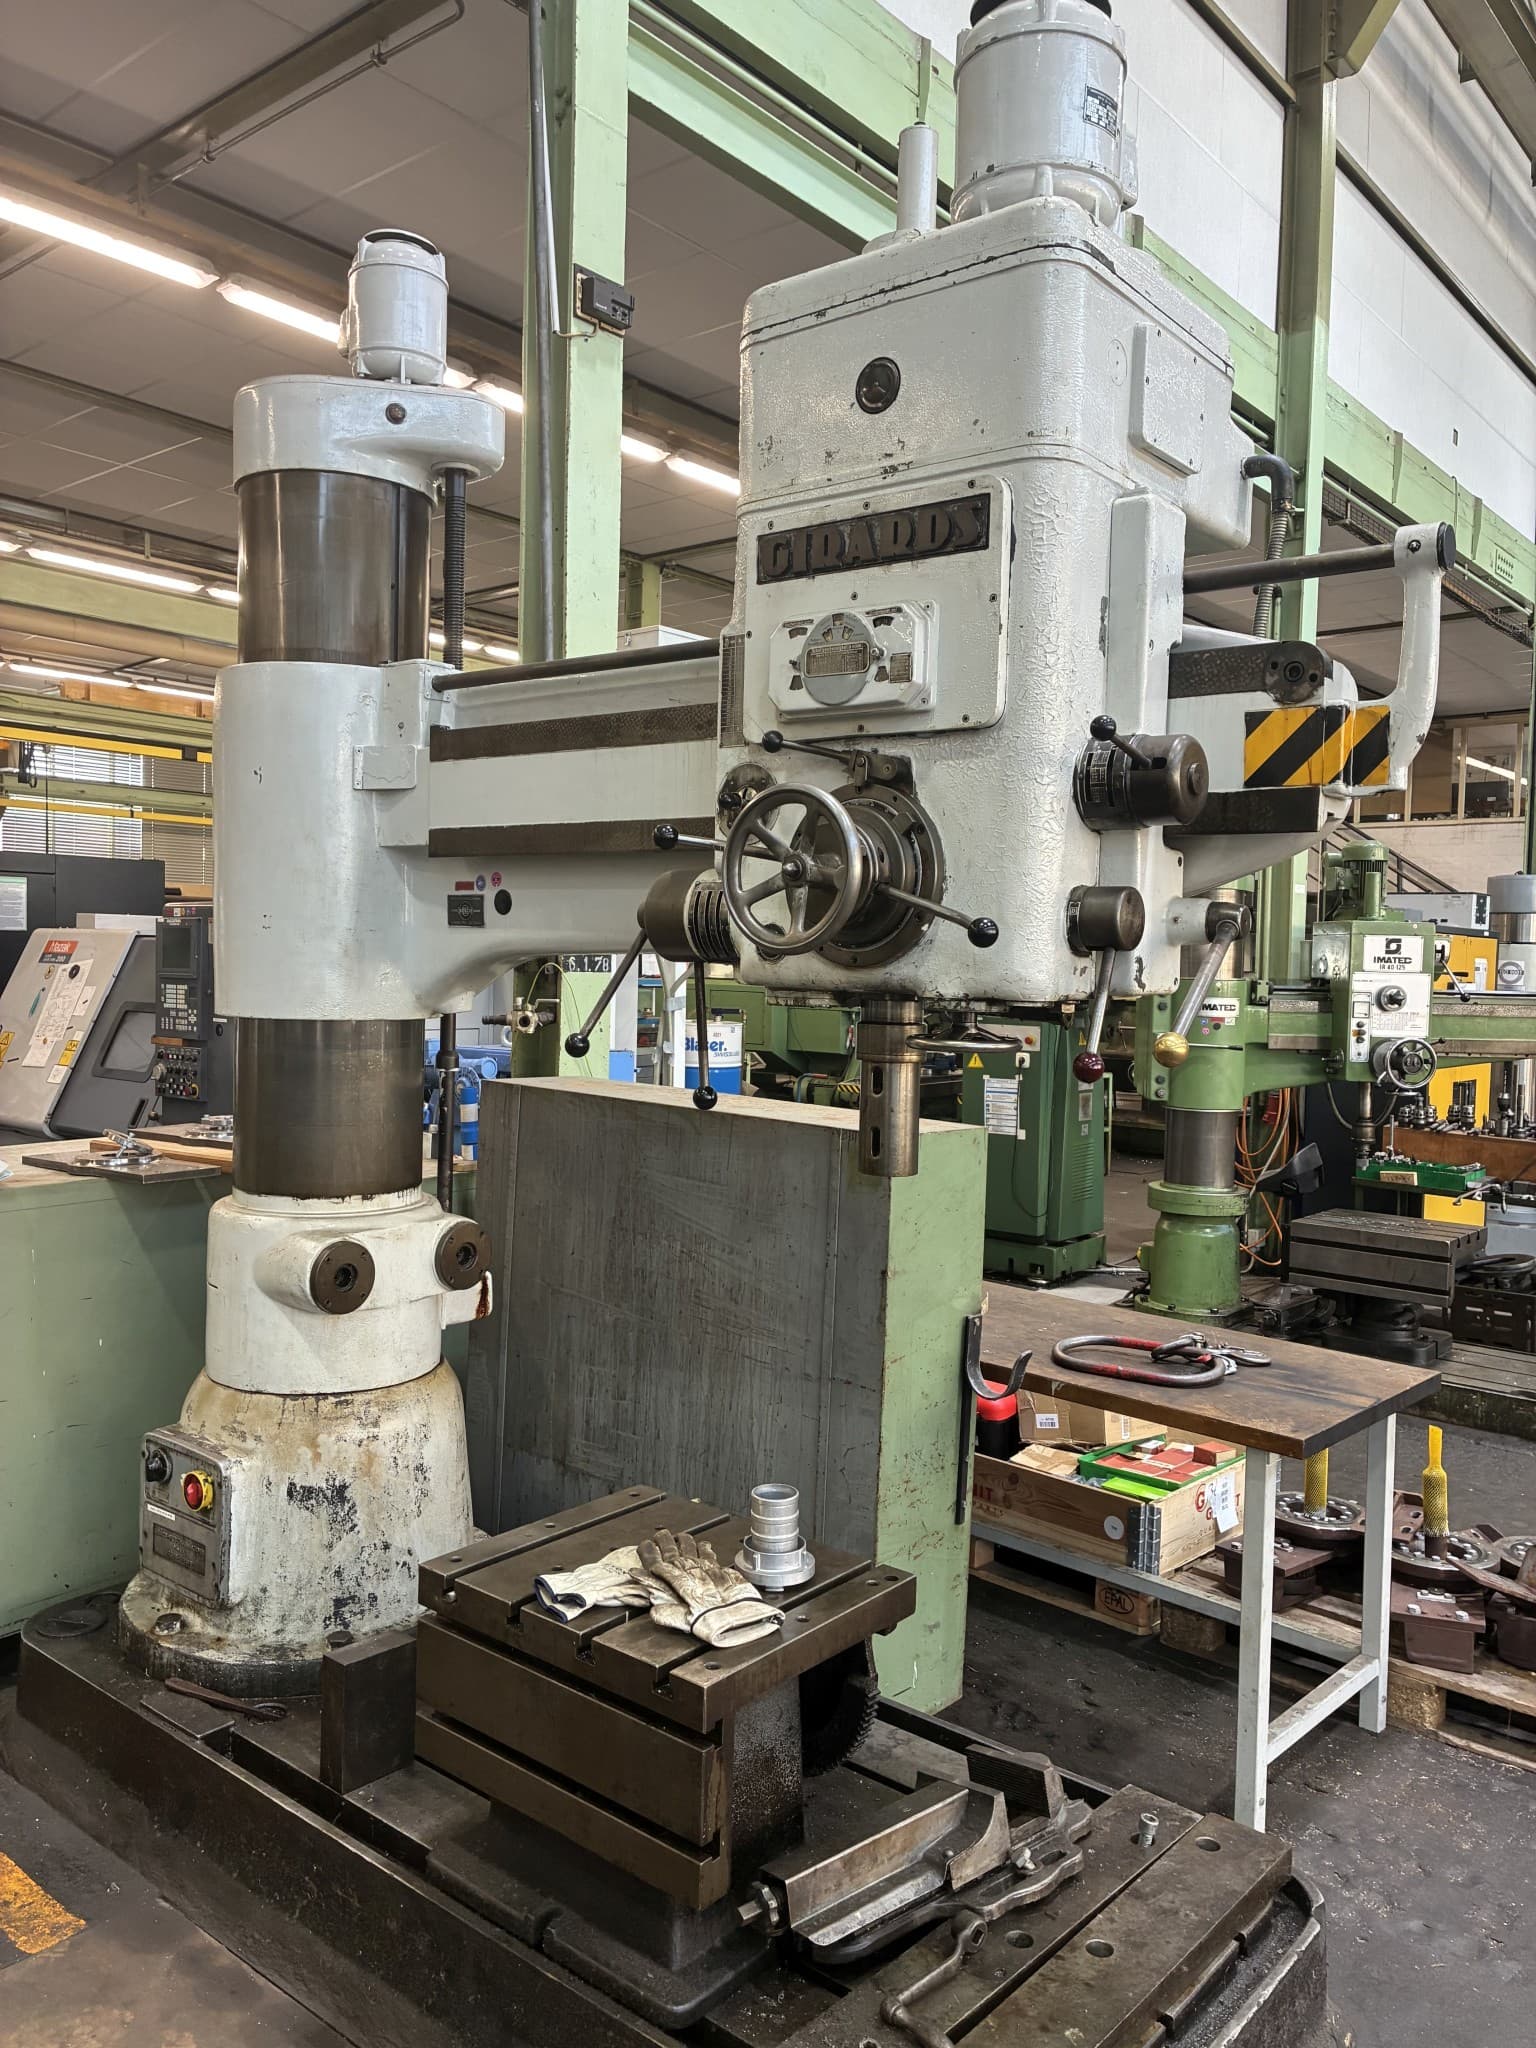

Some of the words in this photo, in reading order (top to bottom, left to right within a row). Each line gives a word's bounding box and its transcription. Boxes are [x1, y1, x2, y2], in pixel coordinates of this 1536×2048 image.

[1373, 956, 1412, 964] IMATEC
[1202, 1003, 1236, 1011] MATEC
[1104, 1590, 1129, 1611] EPAL
